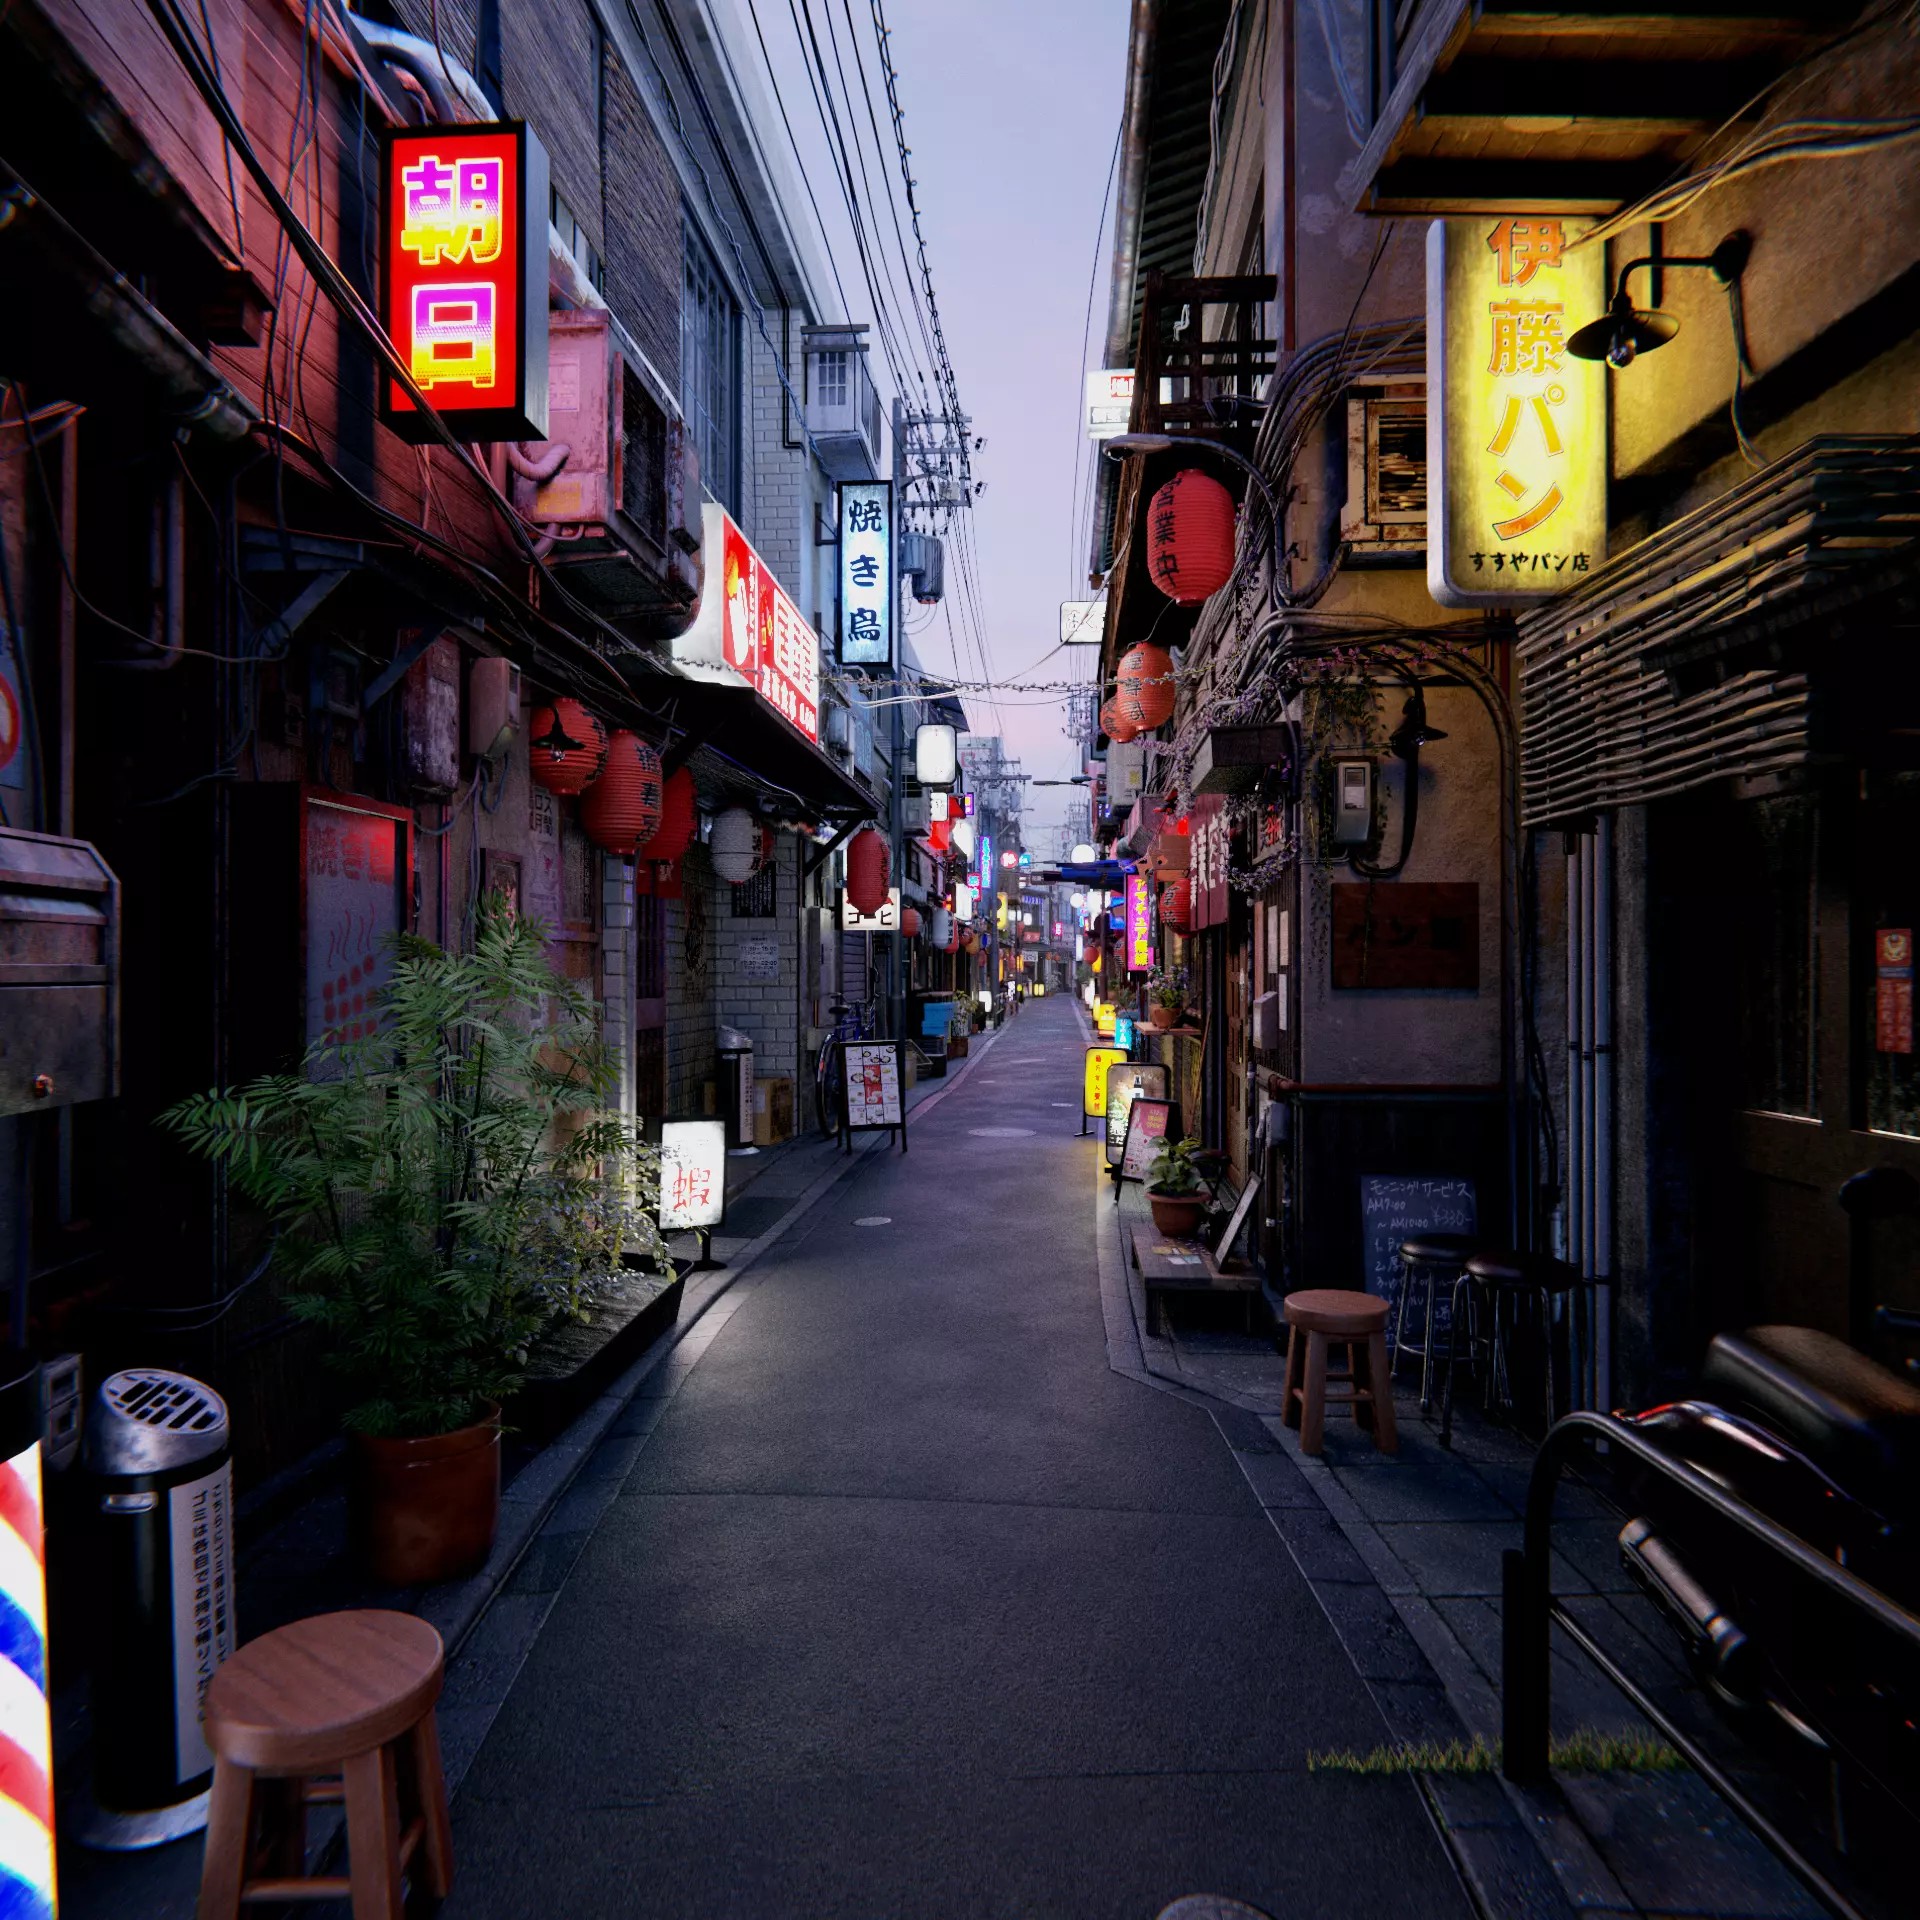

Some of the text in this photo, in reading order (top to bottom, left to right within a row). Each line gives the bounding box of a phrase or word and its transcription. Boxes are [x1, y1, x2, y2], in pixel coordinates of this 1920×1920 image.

[401, 155, 503, 390] 朝日
[1487, 219, 1567, 541] 伊藤パン
[848, 500, 883, 642] 焼き鳥
[1468, 551, 1591, 574] すすやパン店
